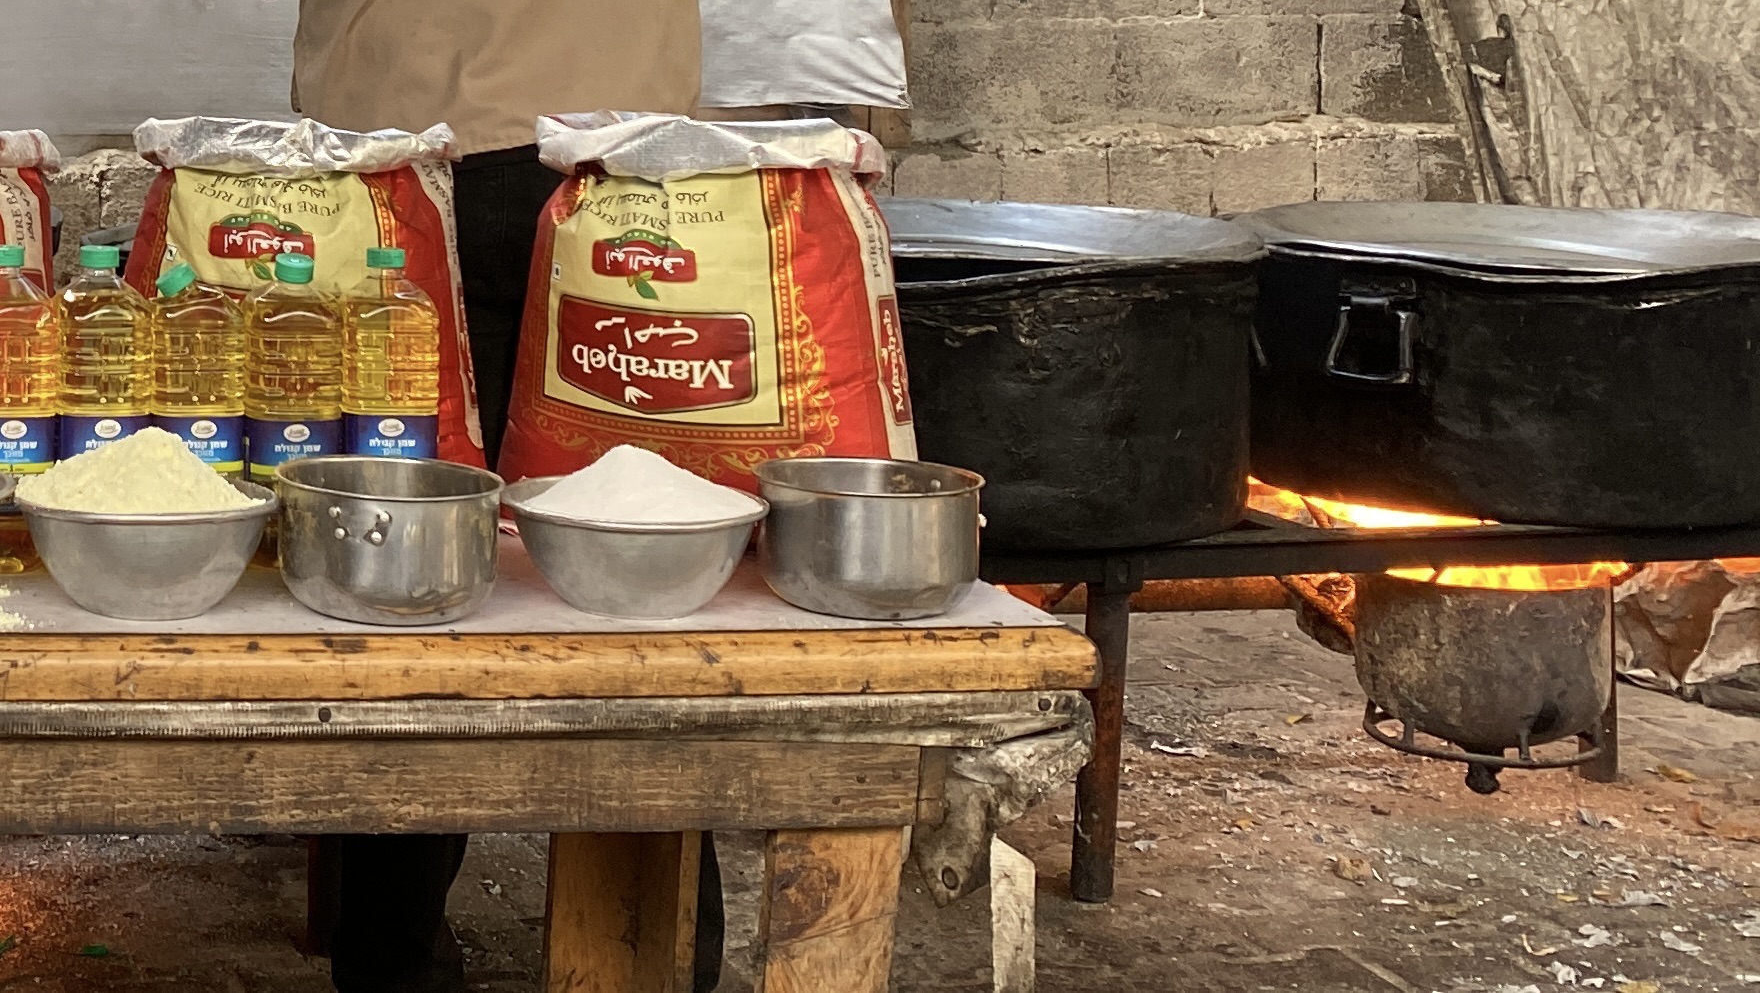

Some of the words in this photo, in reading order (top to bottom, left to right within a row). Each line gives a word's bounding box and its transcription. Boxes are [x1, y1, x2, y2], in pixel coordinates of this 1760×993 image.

[193, 182, 234, 203] RICE
[675, 191, 709, 207] فاخر
[296, 200, 341, 217] PURE
[580, 199, 618, 227] RICE
[674, 210, 726, 225] PURE
[10, 208, 25, 246] URE
[571, 343, 734, 390] Maraheb
